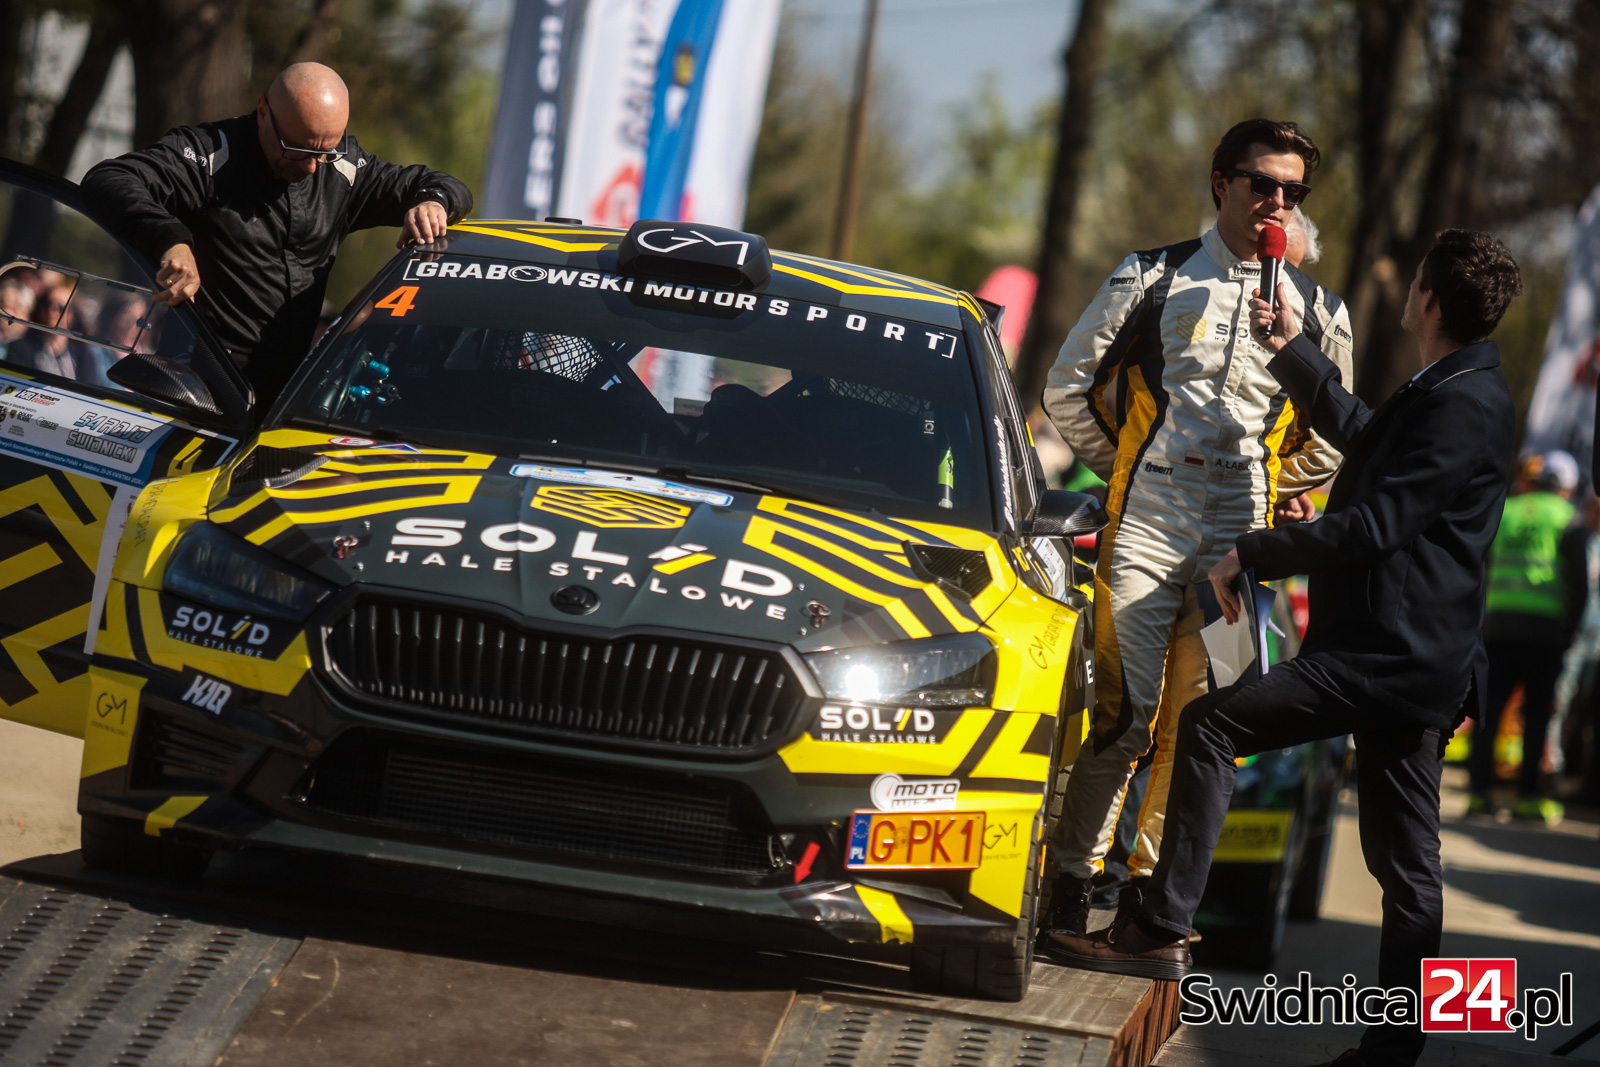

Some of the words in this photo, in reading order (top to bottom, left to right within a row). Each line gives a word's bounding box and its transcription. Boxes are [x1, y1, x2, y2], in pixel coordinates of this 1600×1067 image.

[374, 286, 420, 317] 4
[66, 428, 138, 463] ŚWIDNICKI
[1145, 461, 1174, 476] freem
[385, 550, 514, 572] HALE
[549, 561, 787, 621] STALOWE
[172, 606, 270, 645] SOLID
[168, 630, 198, 644] HALE
[203, 639, 264, 659] STALOWE
[820, 706, 935, 732] SOLID
[821, 733, 861, 743] HALE
[869, 734, 936, 745] STALOWE
[894, 783, 958, 797] MOTO
[850, 846, 866, 861] PL
